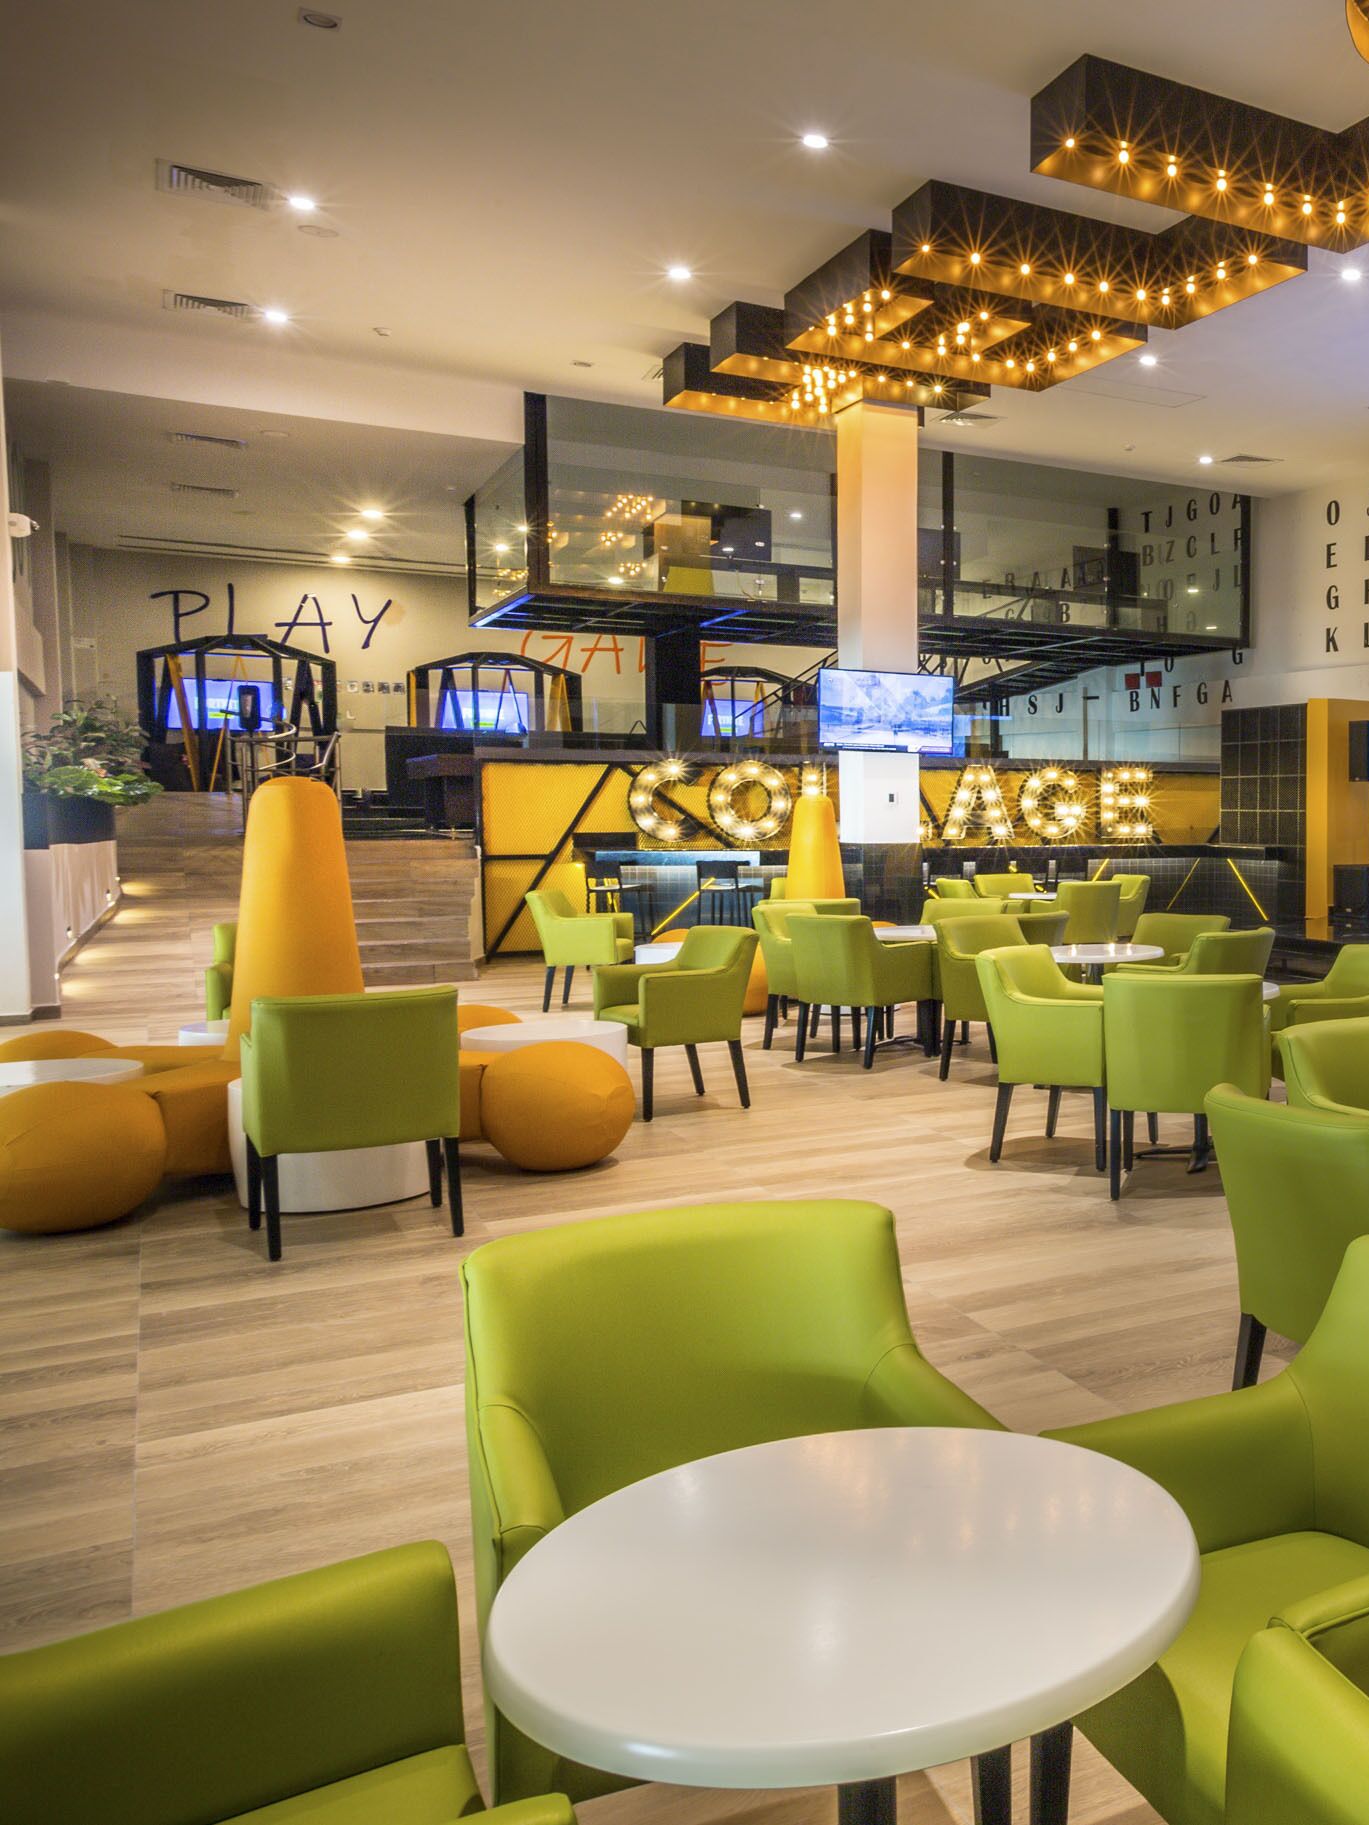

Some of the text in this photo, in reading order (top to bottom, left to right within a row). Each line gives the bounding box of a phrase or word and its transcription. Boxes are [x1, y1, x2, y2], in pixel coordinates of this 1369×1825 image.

[1326, 500, 1340, 526] O
[1326, 542, 1338, 569] E
[1326, 584, 1340, 610] G
[150, 583, 392, 654] PLAY
[1326, 627, 1340, 653] K
[520, 630, 733, 686] GAE
